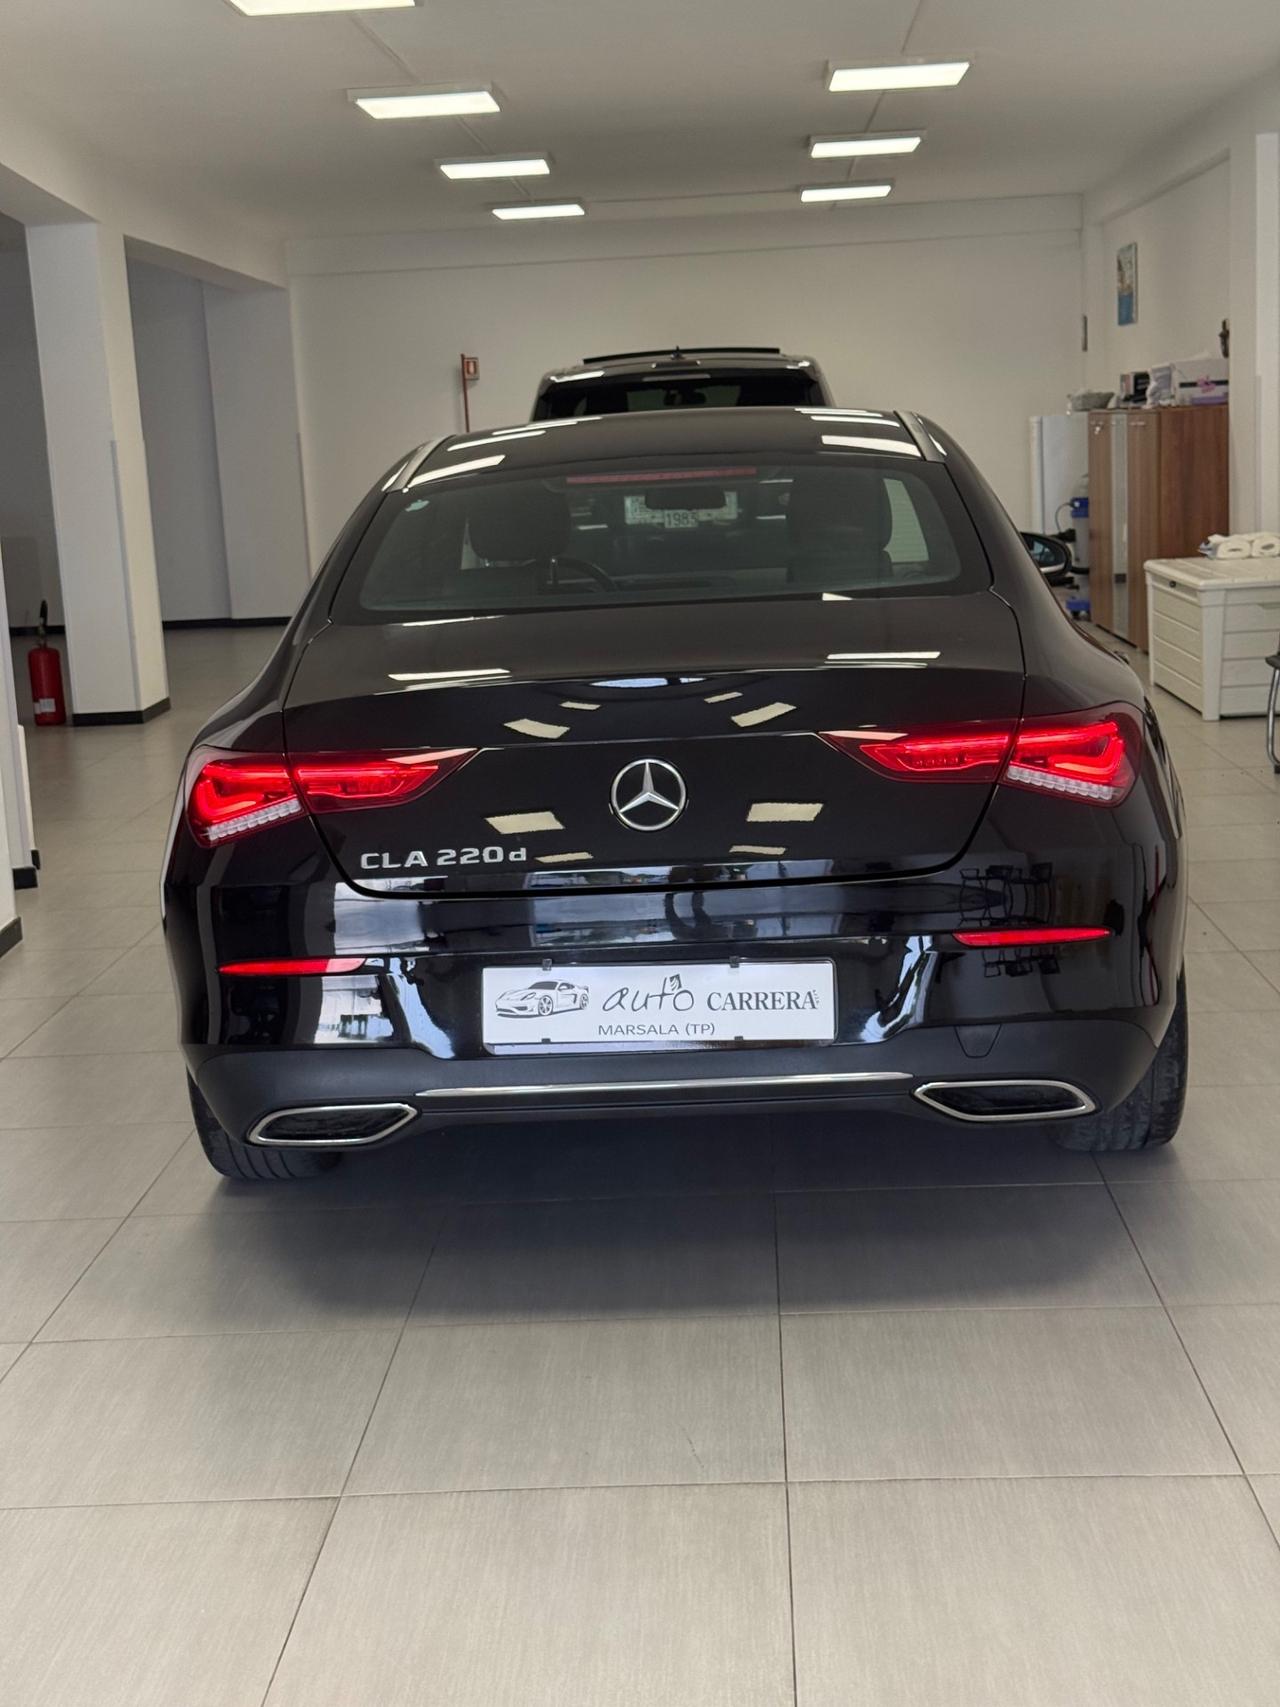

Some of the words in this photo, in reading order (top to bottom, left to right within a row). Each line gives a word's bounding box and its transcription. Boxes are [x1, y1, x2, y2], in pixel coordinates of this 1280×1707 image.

[360, 851, 428, 870] CLA
[602, 974, 694, 1012] auto
[706, 991, 818, 1012] CARRERA
[598, 1024, 679, 1036] MARSALA
[685, 1022, 715, 1036] (TP)
